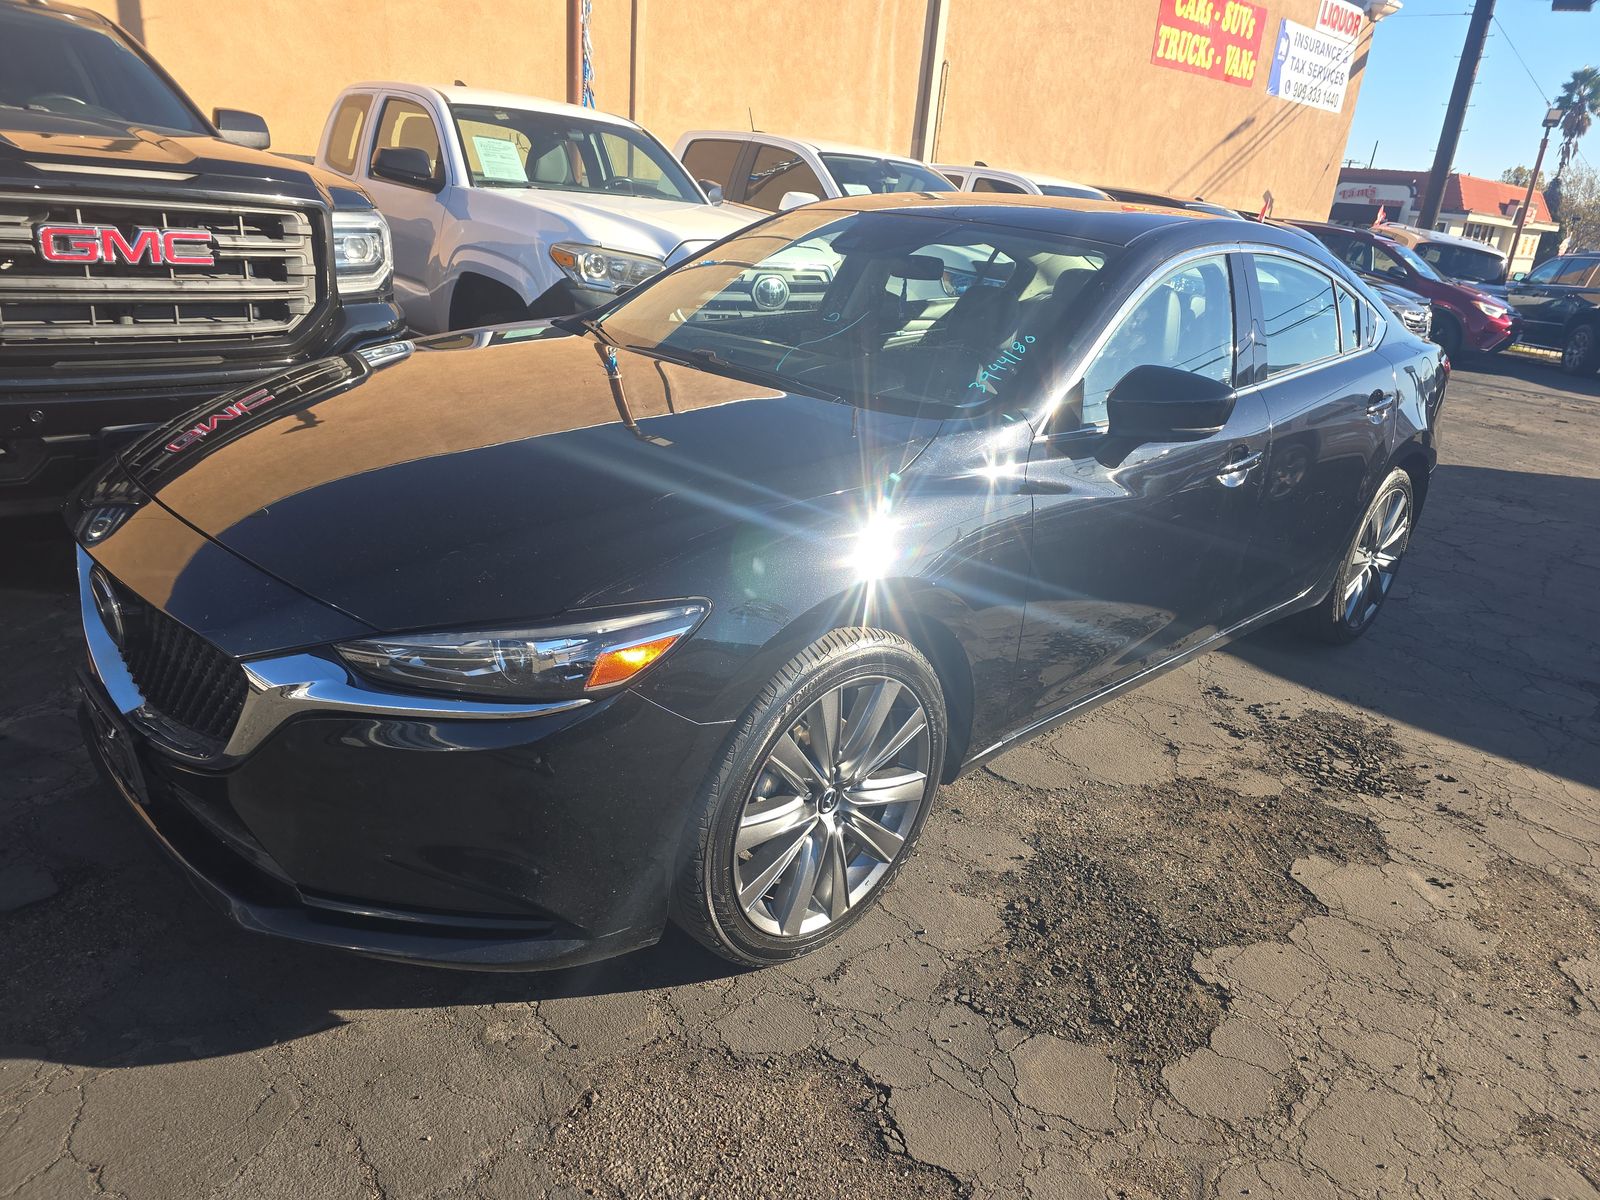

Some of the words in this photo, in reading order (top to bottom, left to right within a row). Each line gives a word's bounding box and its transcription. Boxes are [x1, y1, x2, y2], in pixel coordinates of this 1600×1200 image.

[1320, 0, 1361, 38] LIQUOR
[1294, 32, 1343, 61] INSURANCE
[1290, 56, 1307, 75] TAX
[1307, 62, 1345, 86] SERVICES
[38, 223, 215, 267] GMC
